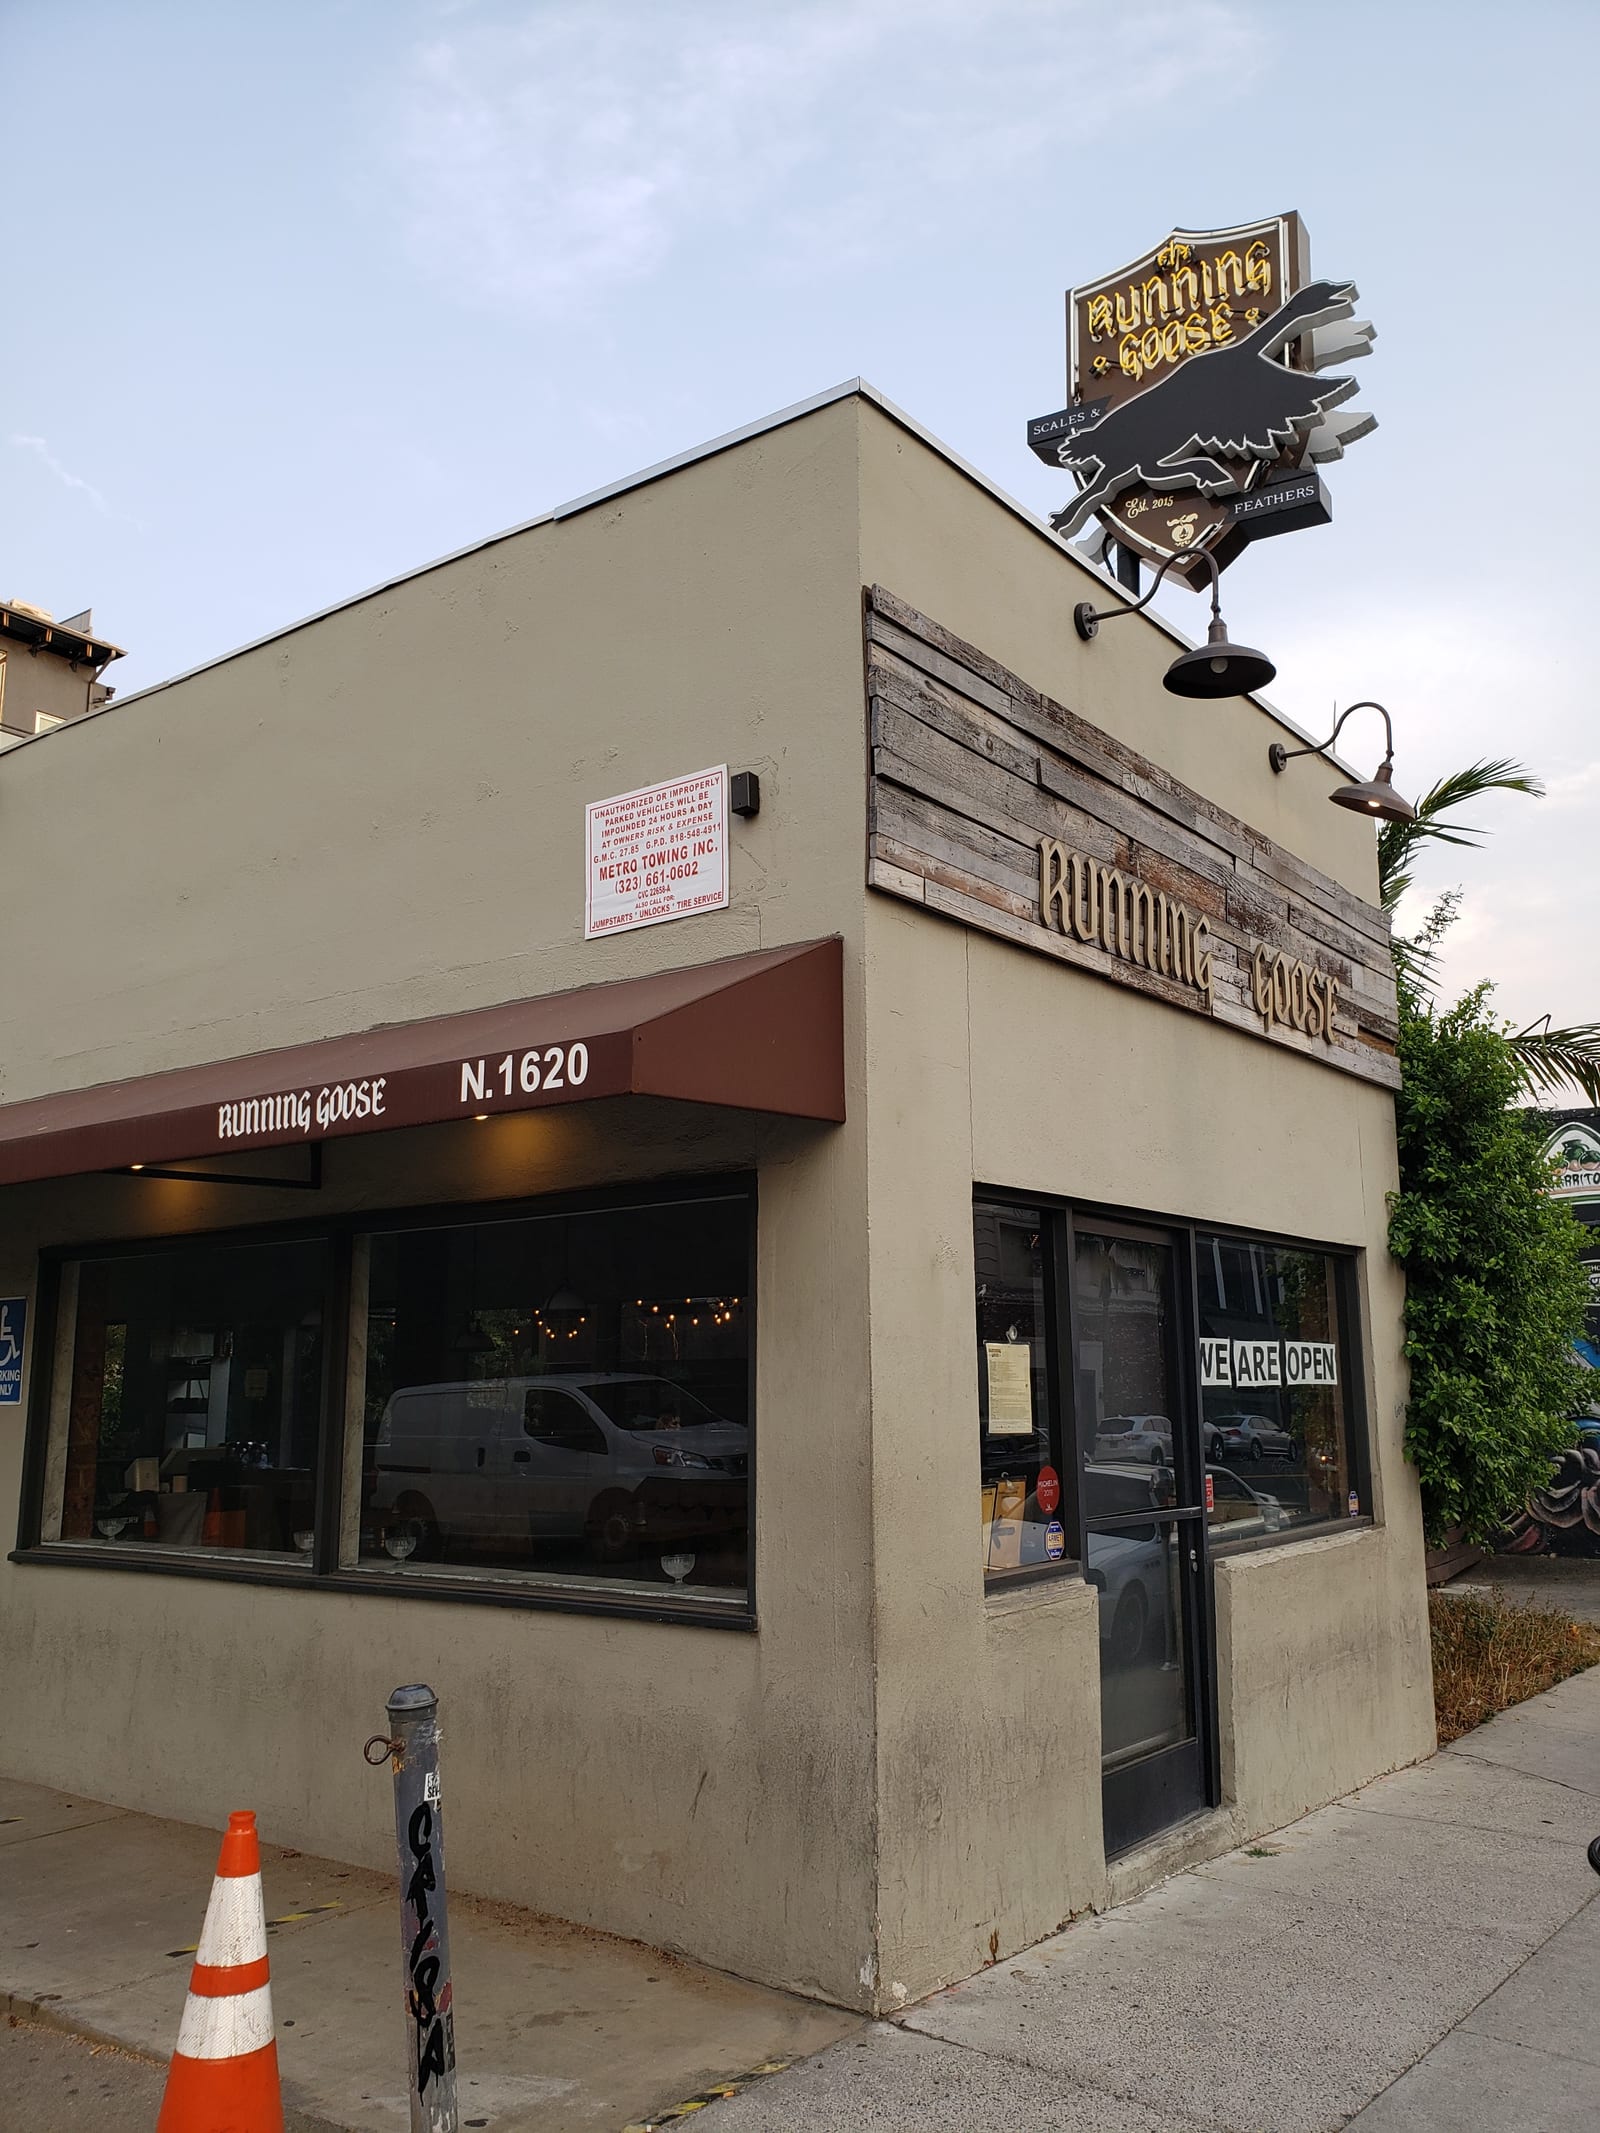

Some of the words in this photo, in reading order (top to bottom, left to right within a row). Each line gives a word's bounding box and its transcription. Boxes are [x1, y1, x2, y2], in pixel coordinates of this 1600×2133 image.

[1087, 240, 1271, 339] RUNNING
[1119, 302, 1237, 381] GOOSE
[1033, 412, 1085, 435] SCALES
[1090, 408, 1101, 418] &
[1125, 497, 1149, 518] Est.
[1152, 496, 1174, 510] 2015
[1234, 485, 1315, 515] FEATHERS
[595, 796, 654, 819] UNAUTHORIZED
[656, 793, 667, 802] OR
[669, 777, 720, 797] IMPROPERLY
[605, 812, 634, 827] PARKED
[636, 800, 675, 818] VEHICLES
[677, 795, 696, 806] WILL
[698, 791, 709, 801] BE
[602, 820, 646, 838] IMPOUNDED
[649, 816, 658, 825] 24
[660, 807, 687, 821] HOURS
[690, 805, 695, 814] A
[698, 801, 713, 811] DAY
[602, 840, 611, 849] AT
[614, 831, 645, 846] OWNERS
[647, 825, 665, 836] RISK
[668, 823, 673, 831] &
[677, 812, 713, 828] EXPENSE
[594, 851, 617, 864] G.M.C.
[620, 844, 639, 857] 27.85
[646, 838, 667, 850] G.P.D.
[670, 822, 721, 843] 818-548-4911
[599, 859, 637, 881] METRO
[642, 846, 688, 870] TOWING
[693, 839, 718, 857] INC.
[615, 875, 642, 894] (323)
[646, 861, 698, 887] 661-0602
[638, 890, 648, 899] CVC
[592, 912, 633, 929] JUMPSTARTS
[640, 904, 670, 918] UNLOCKS
[677, 898, 692, 909] TIRE
[694, 891, 722, 905] SERVICE
[635, 900, 648, 909] ALSO
[649, 898, 662, 906] CALL
[1037, 837, 1214, 1016] RUNNING
[1251, 942, 1340, 1045] GOOSE
[218, 1091, 310, 1139] RUNNING
[316, 1078, 387, 1130] GOOSE
[0, 1369, 20, 1381] RKING
[1238, 1346, 1279, 1381] ARE
[1288, 1346, 1335, 1381] OPEN
[0, 1383, 13, 1396] NLY
